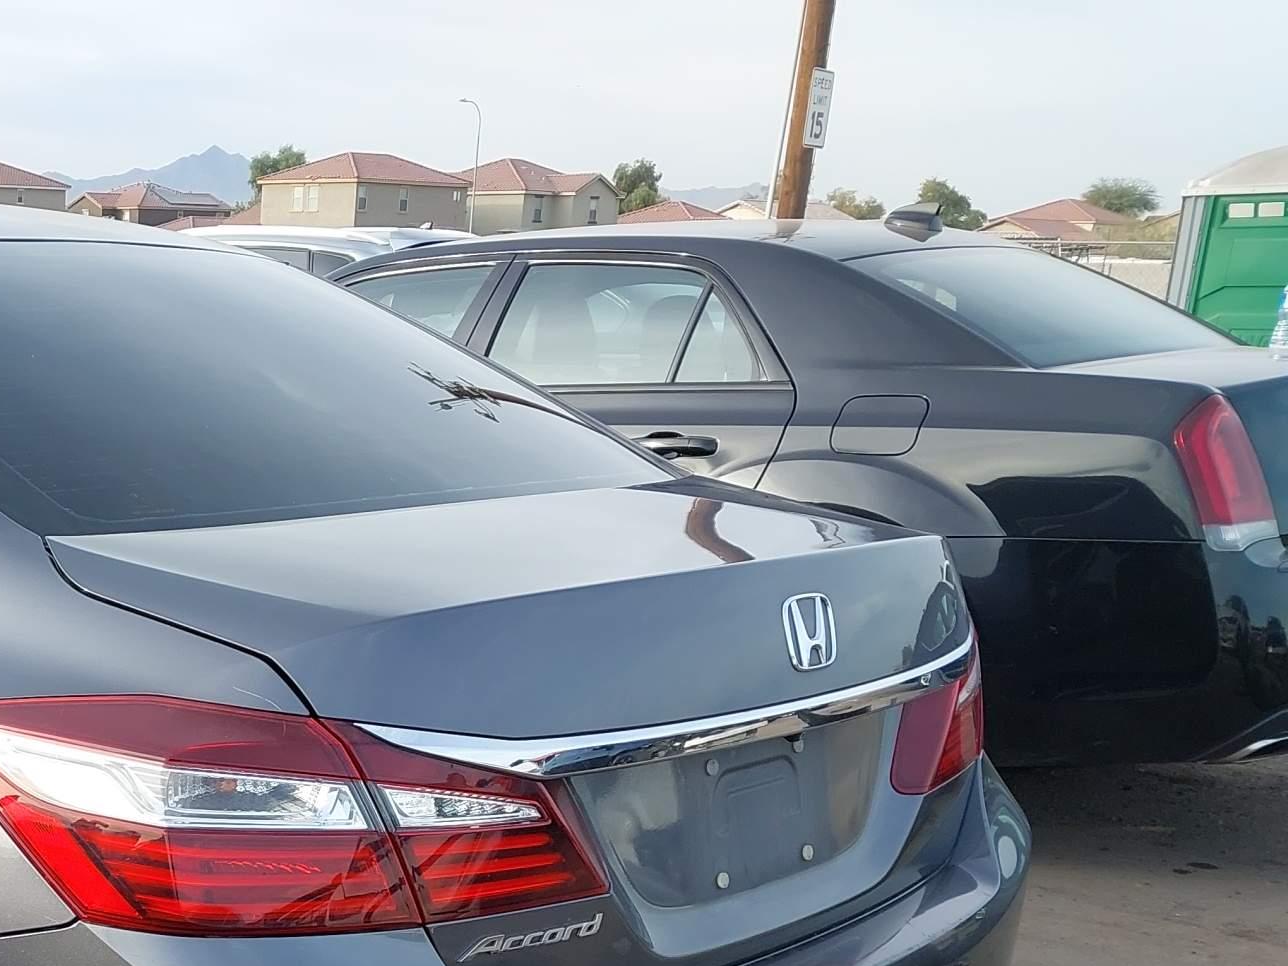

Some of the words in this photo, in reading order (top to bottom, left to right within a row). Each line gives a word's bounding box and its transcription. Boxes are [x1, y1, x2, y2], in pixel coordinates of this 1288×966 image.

[813, 77, 832, 90] SPEED
[813, 93, 828, 106] LIMIT
[809, 110, 824, 139] 15
[456, 912, 604, 963] Accord
